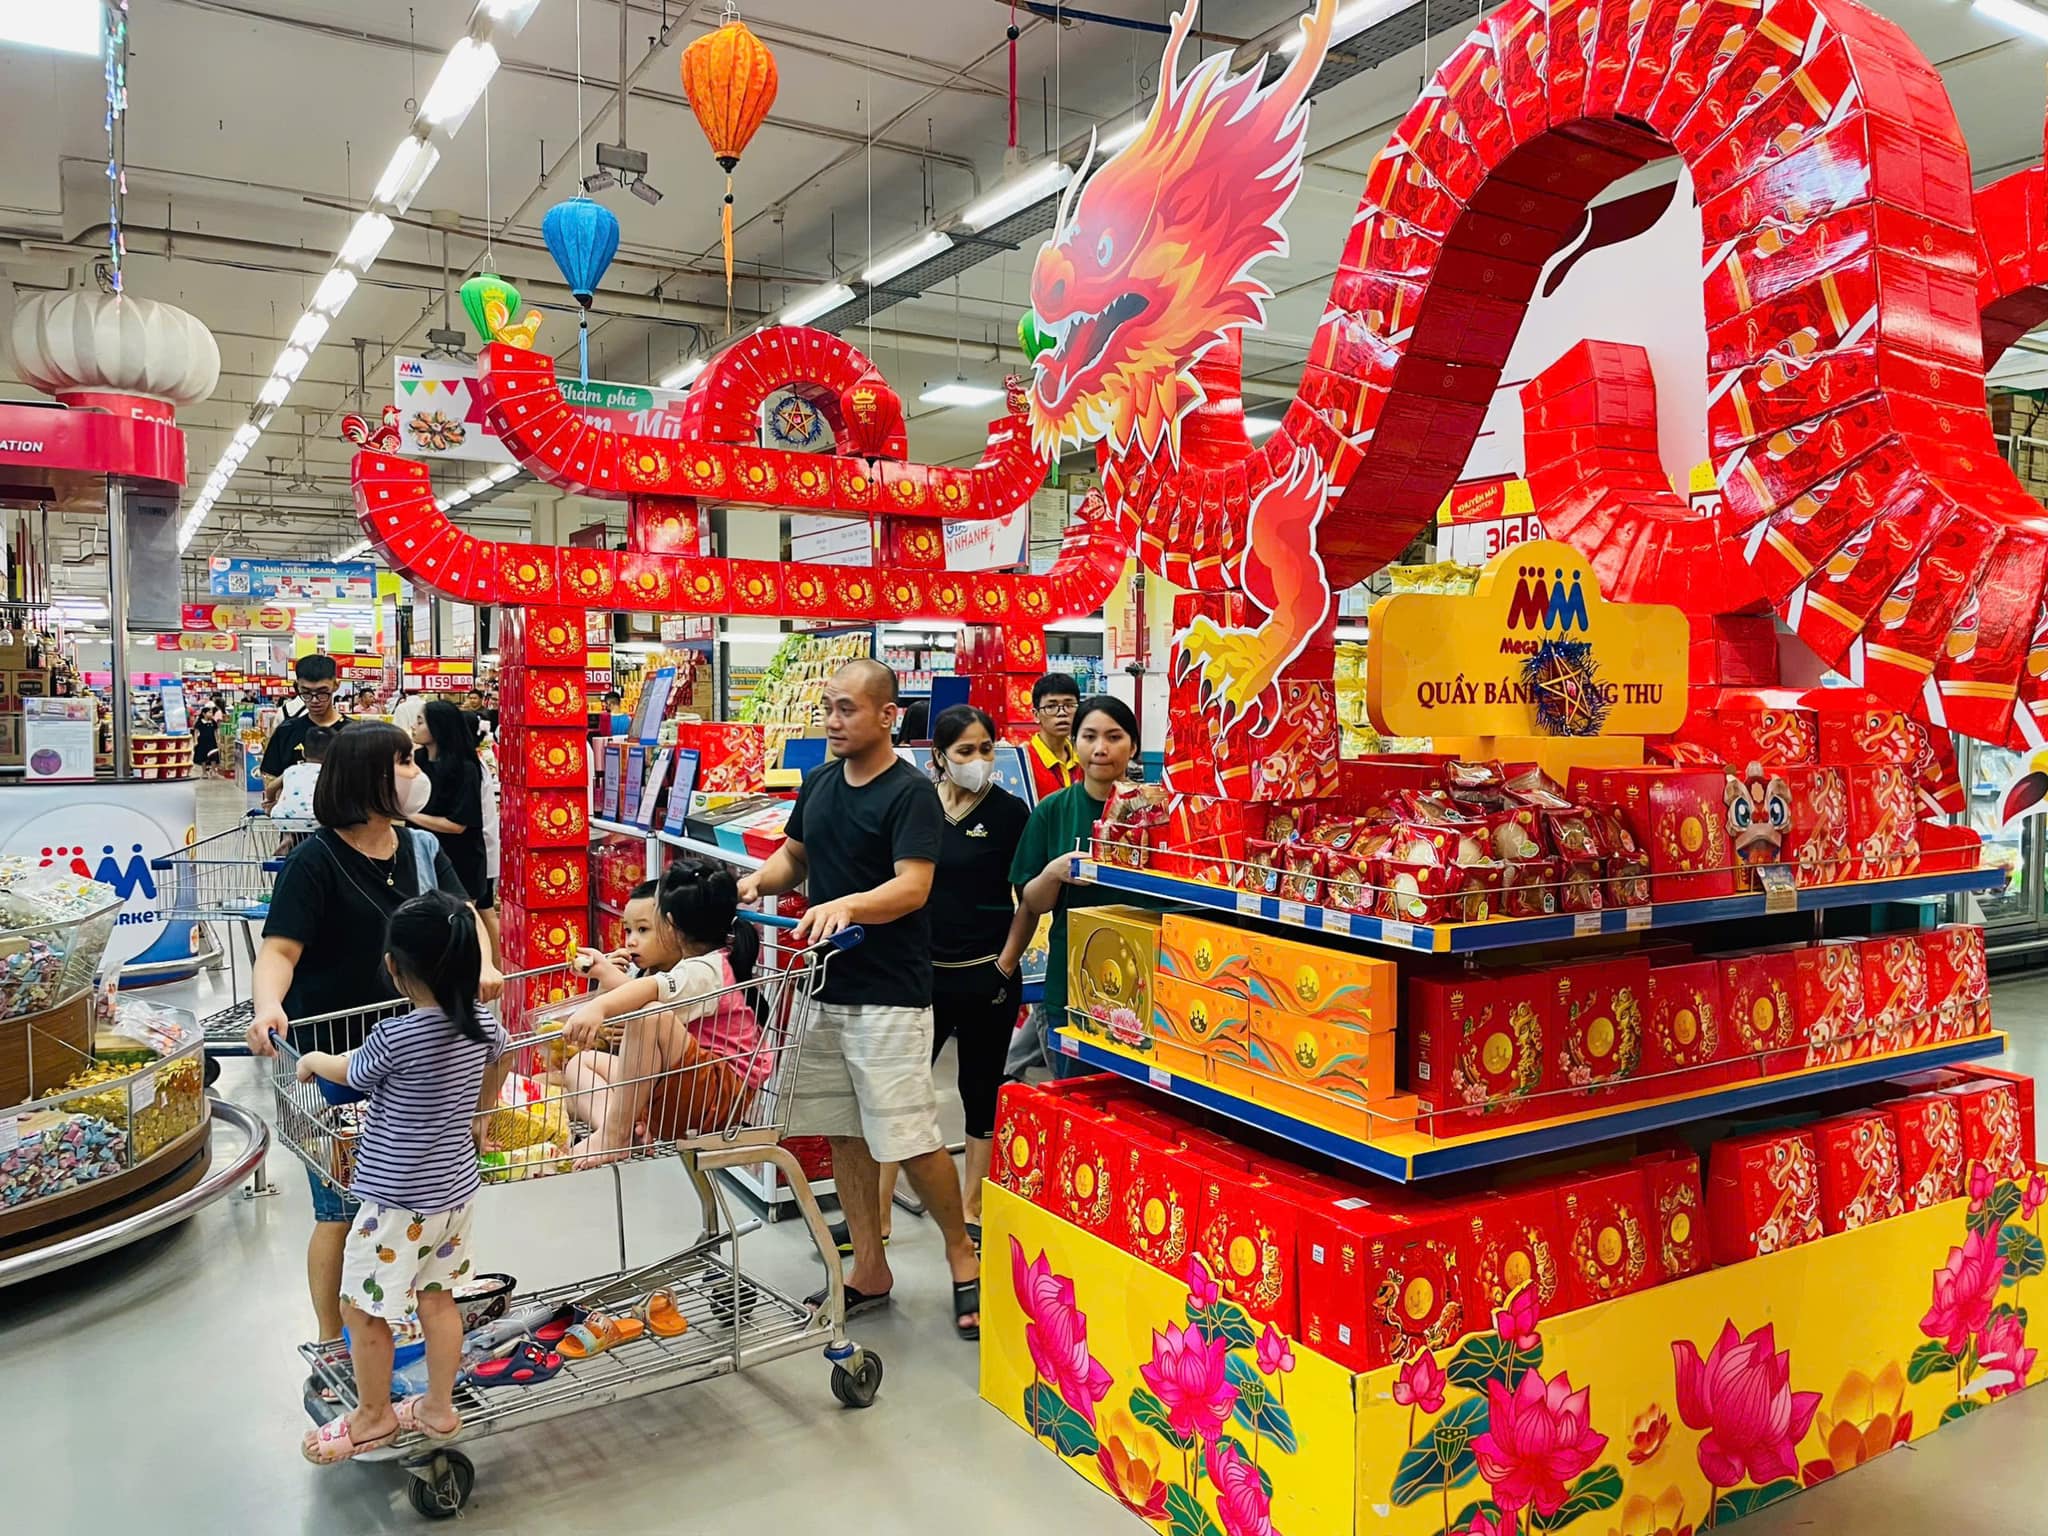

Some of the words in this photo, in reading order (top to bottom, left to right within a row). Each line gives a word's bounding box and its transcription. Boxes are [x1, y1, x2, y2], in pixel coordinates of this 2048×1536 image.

[557, 381, 602, 403] Khám
[606, 389, 638, 408] phá
[253, 565, 283, 574] THÀNH
[428, 677, 450, 688] 159
[1417, 673, 1479, 709] QUẦY
[1623, 684, 1664, 705] THU
